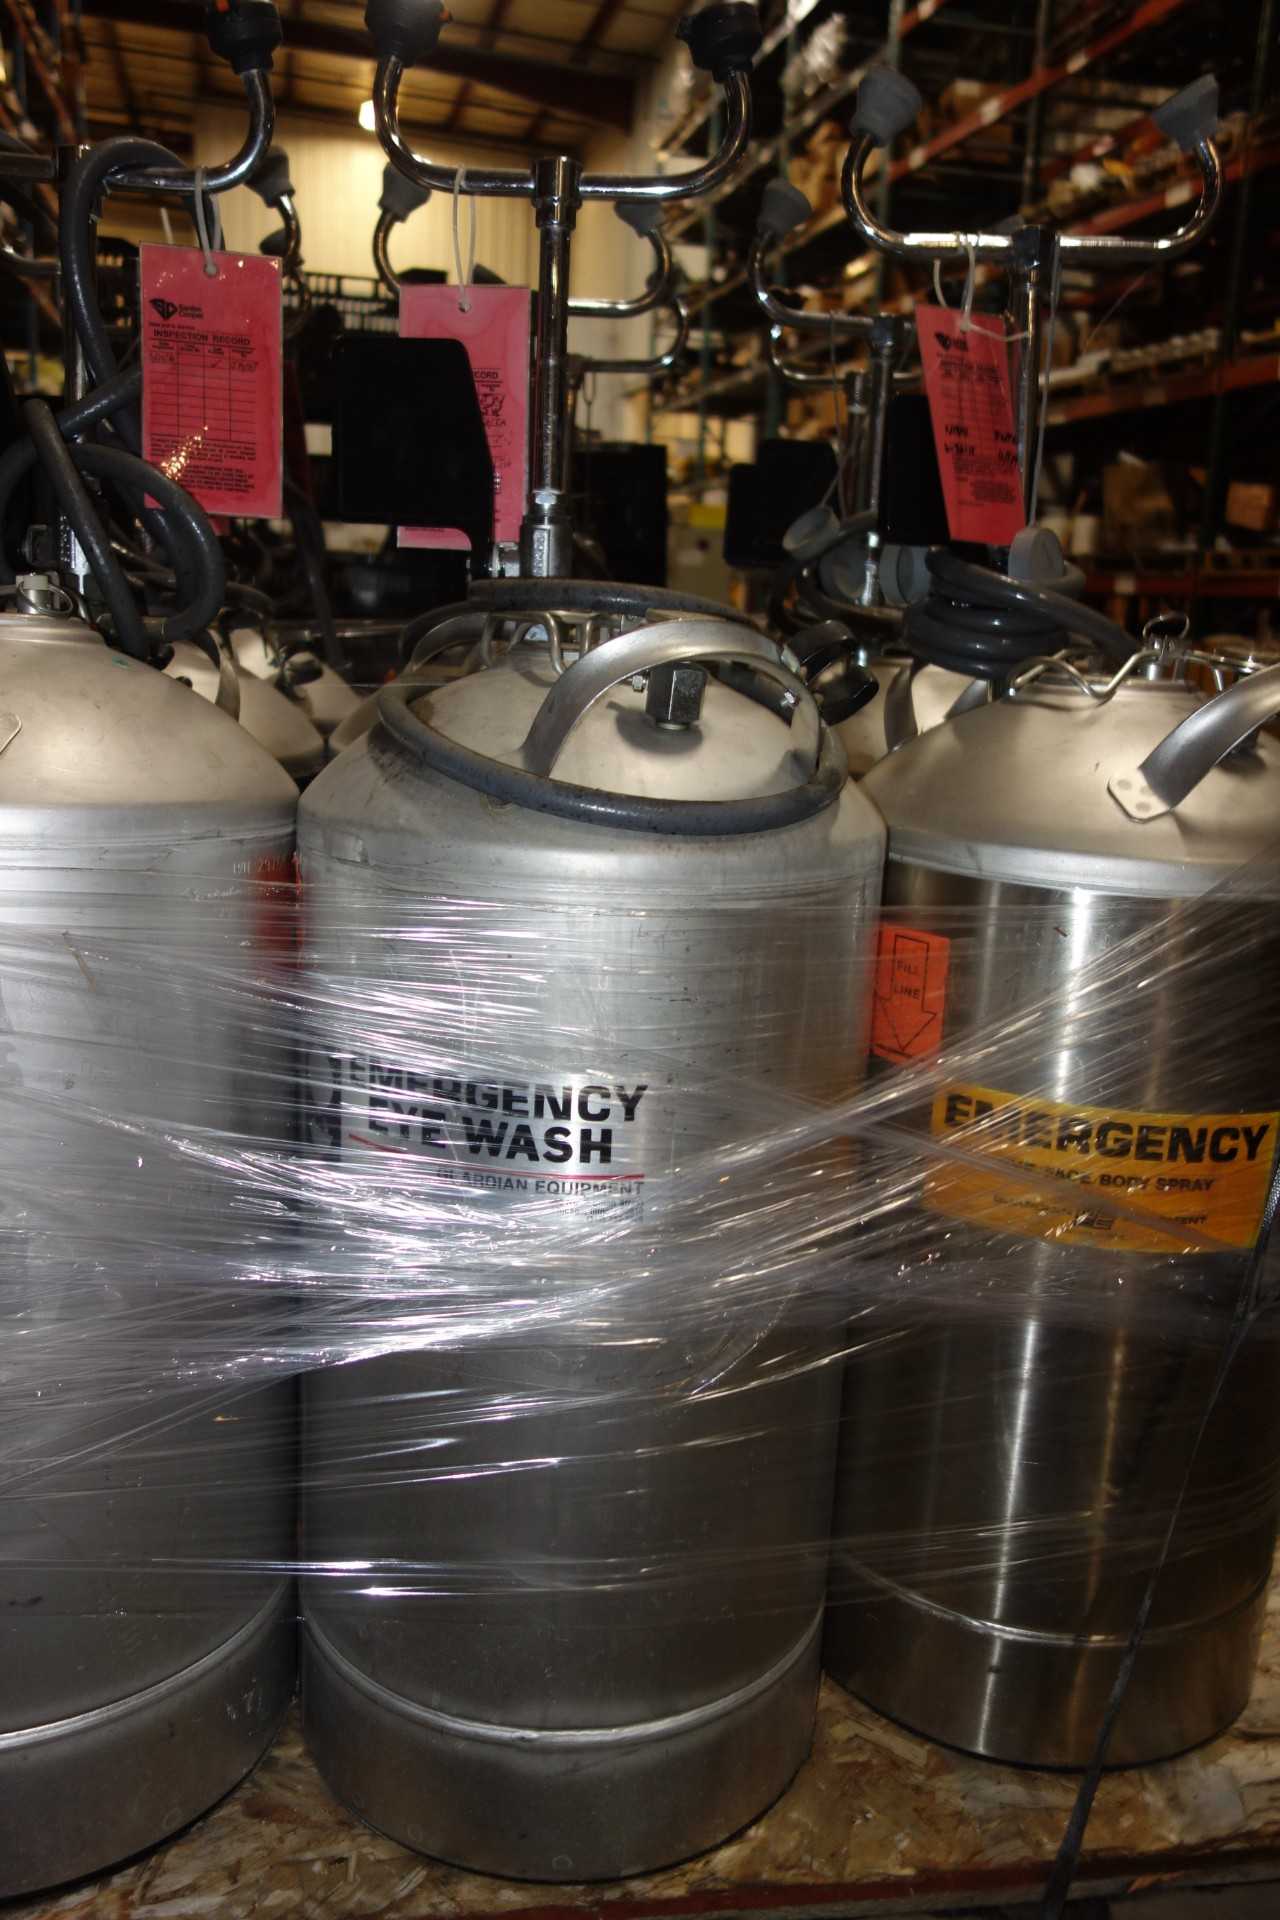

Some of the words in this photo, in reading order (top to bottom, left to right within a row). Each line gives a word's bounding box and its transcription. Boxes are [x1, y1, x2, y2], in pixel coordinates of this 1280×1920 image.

[153, 329, 208, 342] INSPECTION
[212, 335, 250, 346] RECORD
[474, 371, 498, 379] CORD
[896, 961, 918, 976] FILL
[894, 986, 921, 1000] LINE
[350, 1056, 648, 1122] EMERGENCY
[368, 1097, 446, 1149] EYE
[462, 1116, 612, 1164] WASH
[945, 1095, 1269, 1163] EMERGENCY
[535, 1180, 645, 1196] EQUIPMENT
[1155, 1176, 1214, 1192] SPRAY
